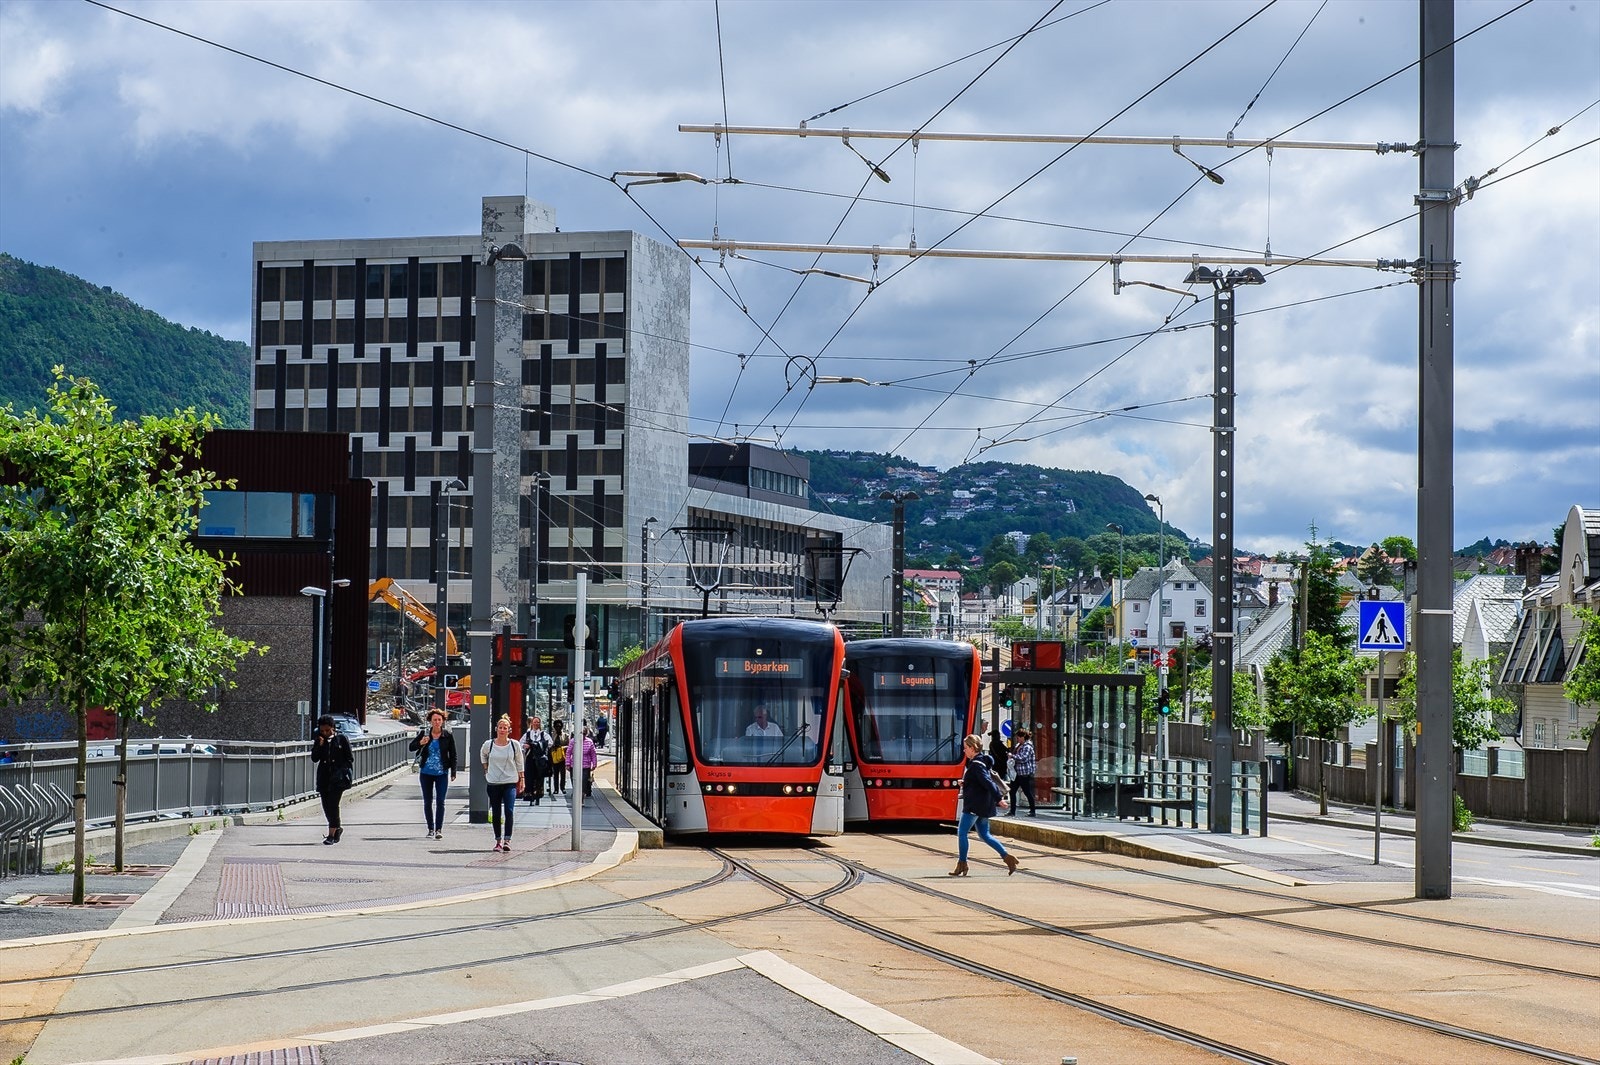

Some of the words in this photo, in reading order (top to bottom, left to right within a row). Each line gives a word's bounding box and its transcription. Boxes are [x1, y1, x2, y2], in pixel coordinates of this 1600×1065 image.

[405, 610, 427, 627] CASE
[723, 661, 728, 672] 1
[744, 660, 789, 674] Byparken
[880, 675, 885, 685] 1
[901, 675, 934, 686] Lagunen
